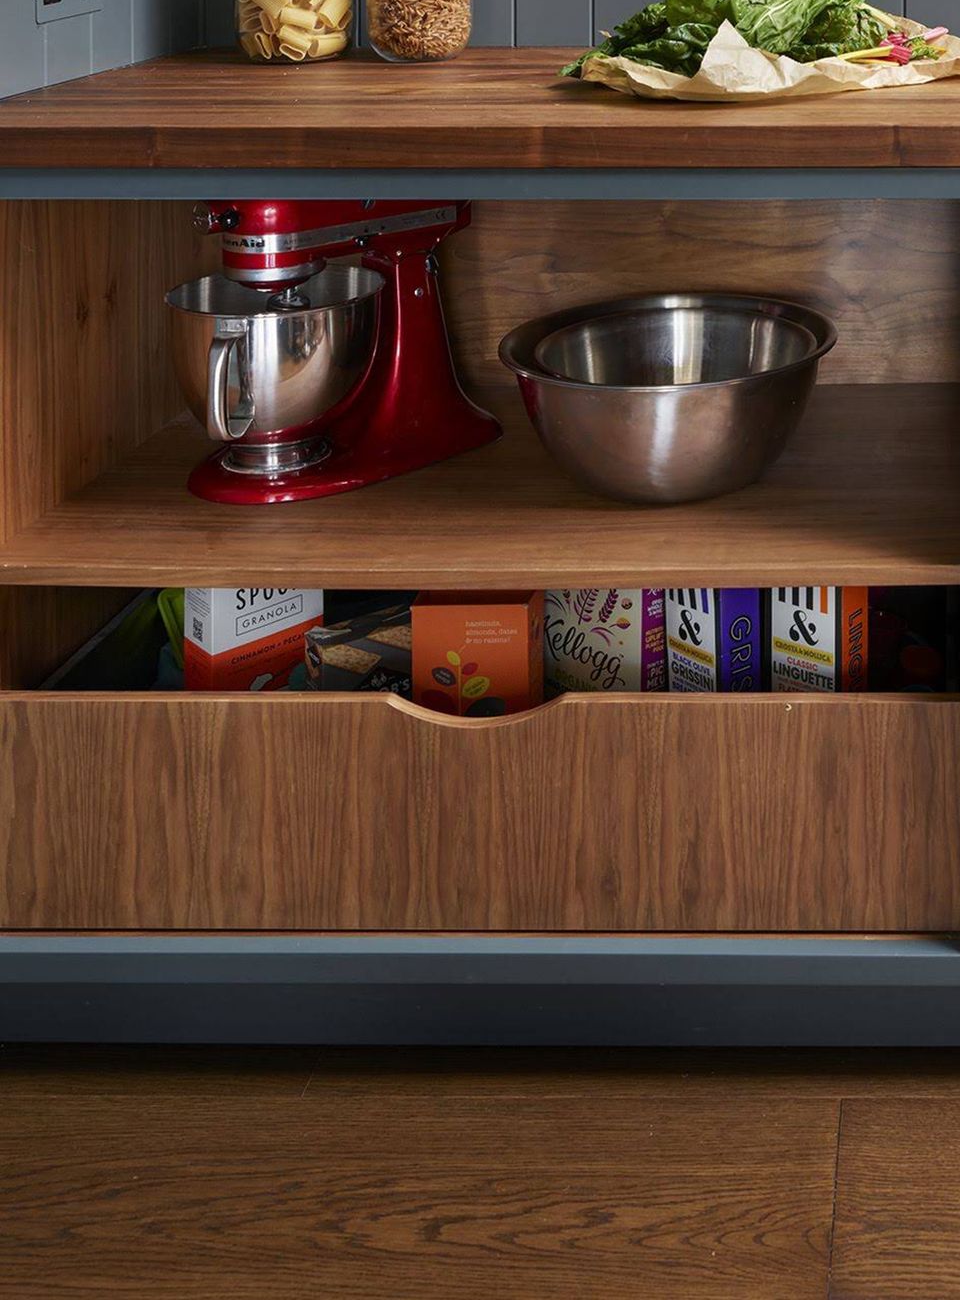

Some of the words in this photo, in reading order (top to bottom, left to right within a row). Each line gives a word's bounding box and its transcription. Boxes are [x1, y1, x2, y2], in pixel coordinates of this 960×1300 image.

[242, 602, 298, 629] GRANOLA
[231, 643, 276, 666] CINNAMON
[544, 615, 625, 689] Kellogg
[730, 615, 753, 692] GRIS
[786, 656, 818, 671] CLASSIC
[671, 661, 715, 692] GRISSINI
[773, 660, 833, 690] LINGUETTE
